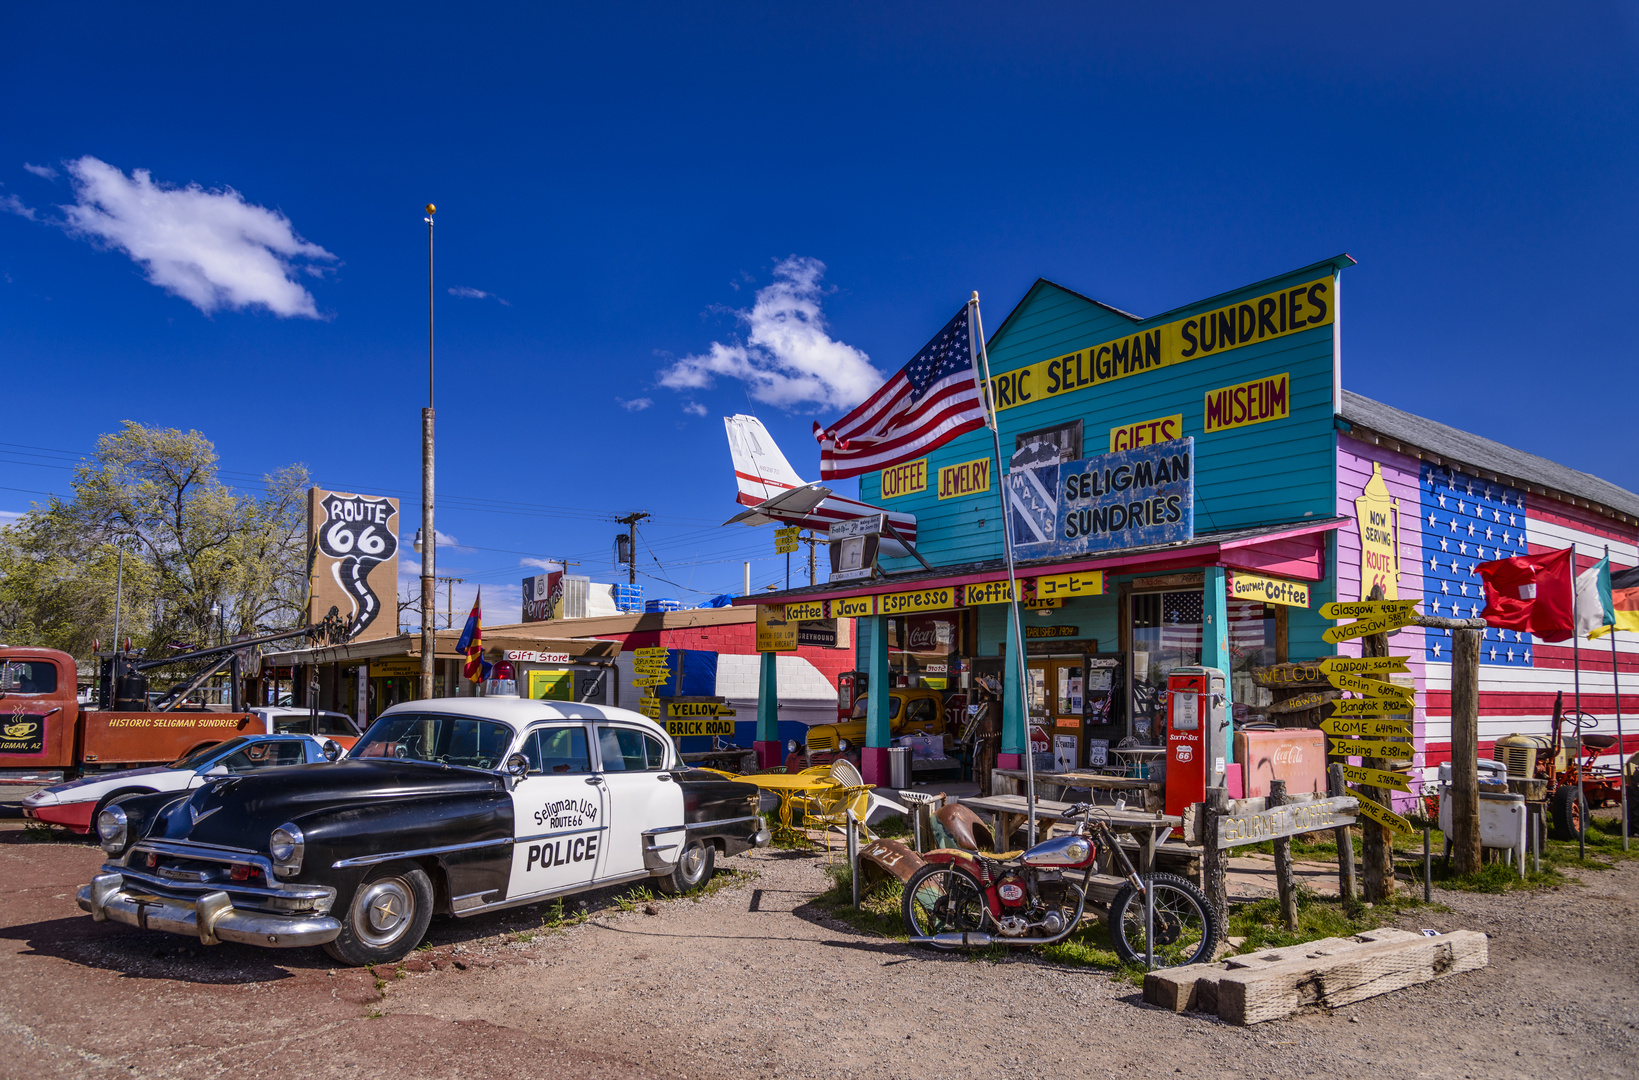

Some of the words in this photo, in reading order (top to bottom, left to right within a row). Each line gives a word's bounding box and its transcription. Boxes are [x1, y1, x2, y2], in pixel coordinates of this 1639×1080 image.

[981, 370, 1031, 410] ORIC
[1047, 329, 1160, 393] SELIGMAN
[1181, 283, 1327, 357] SUNDRIES
[1207, 377, 1286, 429] MUSEUM
[883, 461, 924, 496] COFFEE
[940, 460, 988, 497] JEWELRY
[1065, 453, 1190, 500] SELIGMAN
[331, 501, 386, 524] ROUTE
[1065, 496, 1181, 538] SUNDRIES
[1370, 510, 1386, 527] NOW
[327, 521, 385, 554] 66
[1365, 526, 1391, 547] SERVING
[1366, 550, 1390, 573] ROUTE
[1044, 576, 1093, 594] コーヒー
[1235, 580, 1264, 593] Gourmet
[1265, 581, 1305, 604] Coffee
[837, 601, 867, 616] Java
[883, 590, 948, 613] Espresso
[787, 604, 821, 620] Kaffee
[1331, 619, 1386, 639] Warsaw
[1388, 612, 1406, 622] 5887
[774, 640, 794, 648] AIRCRAFT
[508, 651, 533, 660] Gift
[540, 654, 568, 662] Store
[1392, 660, 1401, 668] mi
[672, 704, 718, 715] YELLOW
[1289, 694, 1322, 709] Howdy
[1340, 701, 1378, 713] Bangkok
[109, 719, 151, 727] HISTORIC
[153, 719, 196, 727] SELIGMAN
[198, 719, 239, 727] SUNDRIES
[670, 722, 702, 734] BRICK
[706, 722, 731, 733] ROAD
[1333, 721, 1368, 733] ROME
[1393, 725, 1402, 733] mi
[1178, 752, 1190, 760] 66
[1338, 741, 1371, 757] Beijing
[1093, 755, 1104, 764] 66
[1343, 766, 1367, 781] Paris
[580, 798, 598, 823] USA
[550, 816, 572, 829] ROUTE
[573, 814, 583, 827] 66
[1224, 811, 1285, 842] GOURMET
[1294, 802, 1335, 829] COFFEE
[527, 835, 598, 872] POLICE
